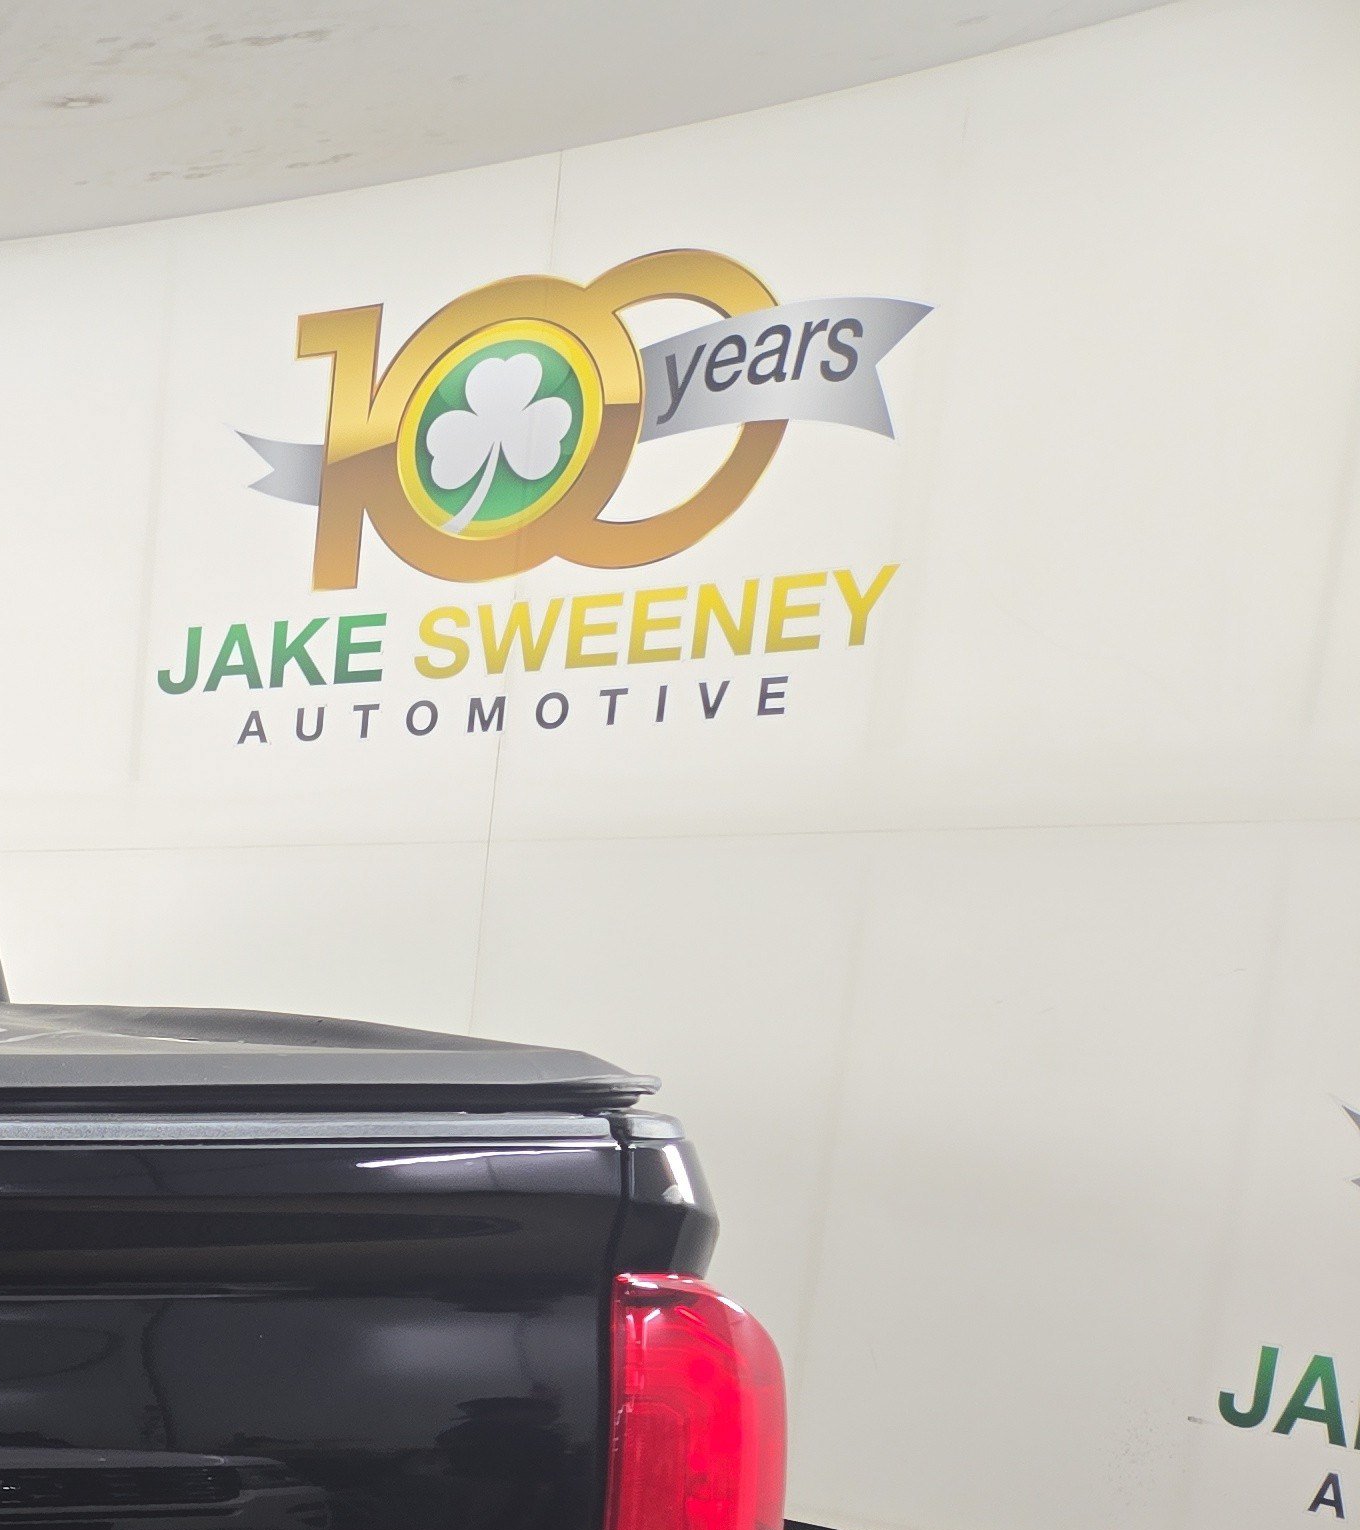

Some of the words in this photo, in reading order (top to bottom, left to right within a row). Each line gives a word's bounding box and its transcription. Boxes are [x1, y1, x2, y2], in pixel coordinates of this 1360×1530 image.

[657, 314, 863, 425] years
[157, 612, 388, 694] JAKE
[413, 563, 901, 679] SWEENEY
[237, 676, 789, 745] AUTOMOTIVE
[1218, 1345, 1360, 1451] JA
